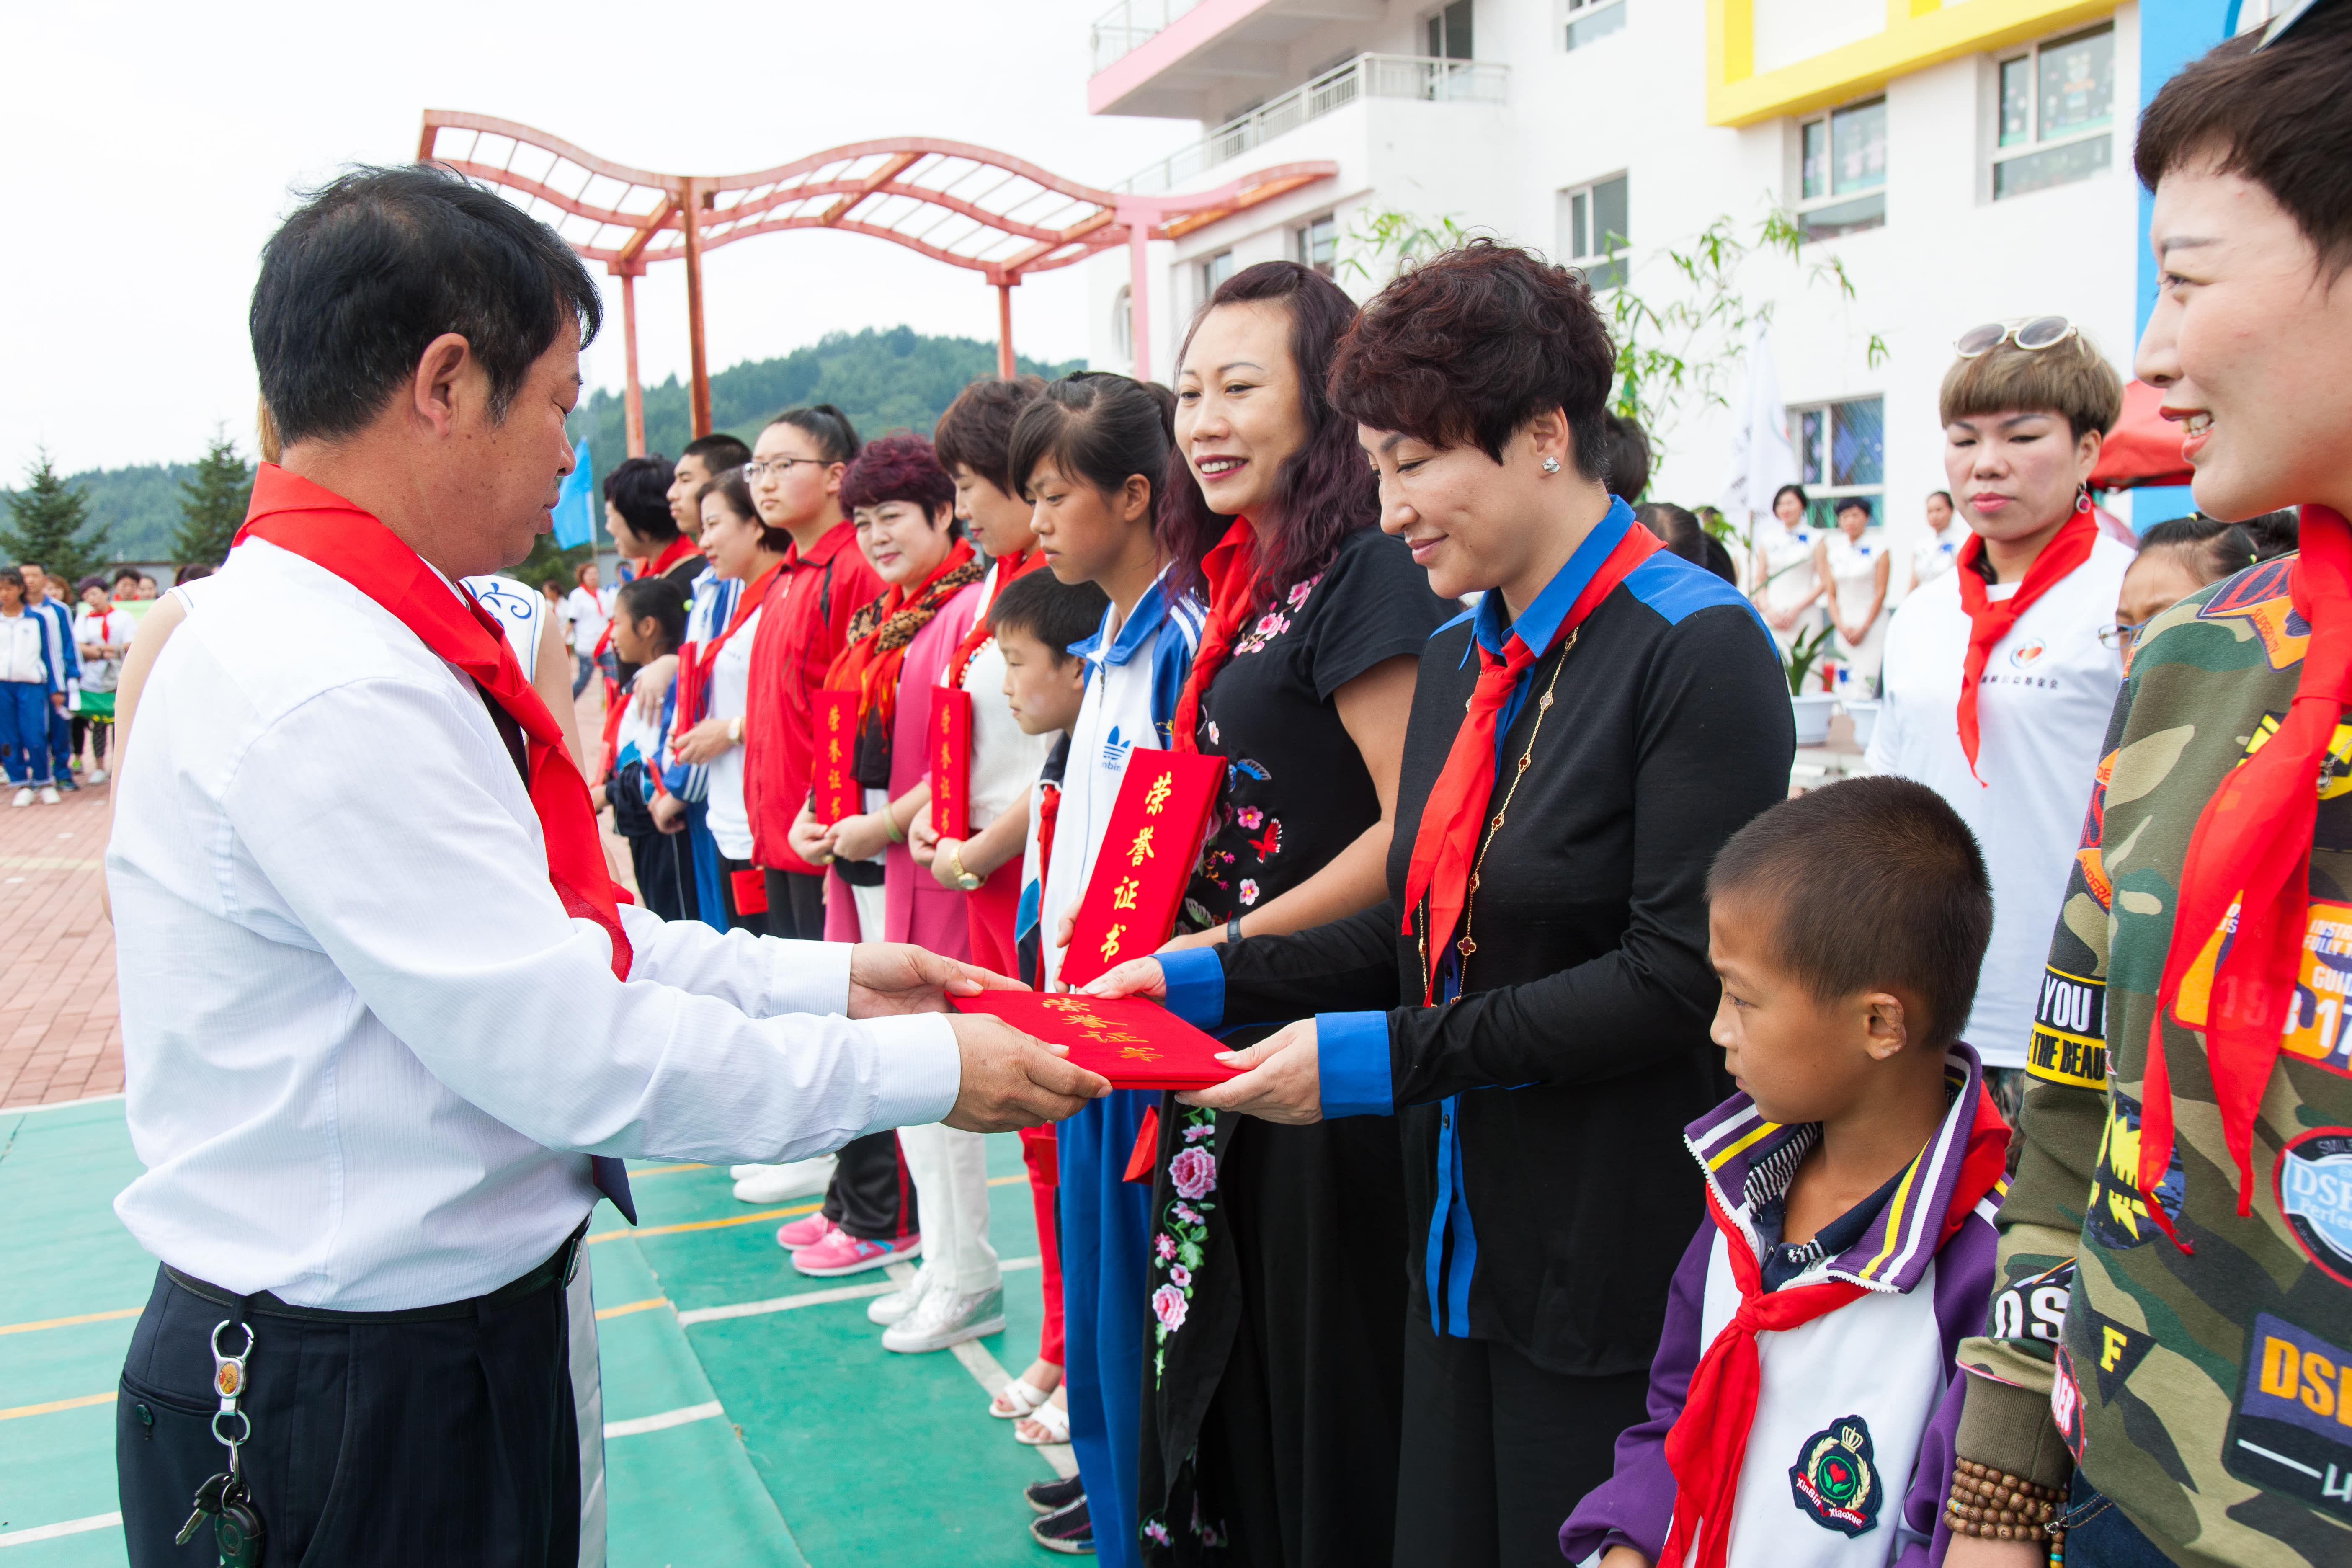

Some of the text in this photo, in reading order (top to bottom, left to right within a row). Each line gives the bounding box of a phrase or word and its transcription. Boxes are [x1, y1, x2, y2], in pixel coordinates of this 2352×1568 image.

[1100, 771, 1172, 963] 荣誉证书
[2040, 975, 2092, 1032] YOU
[2032, 1031, 2059, 1070] THE
[2100, 1325, 2128, 1373] F
